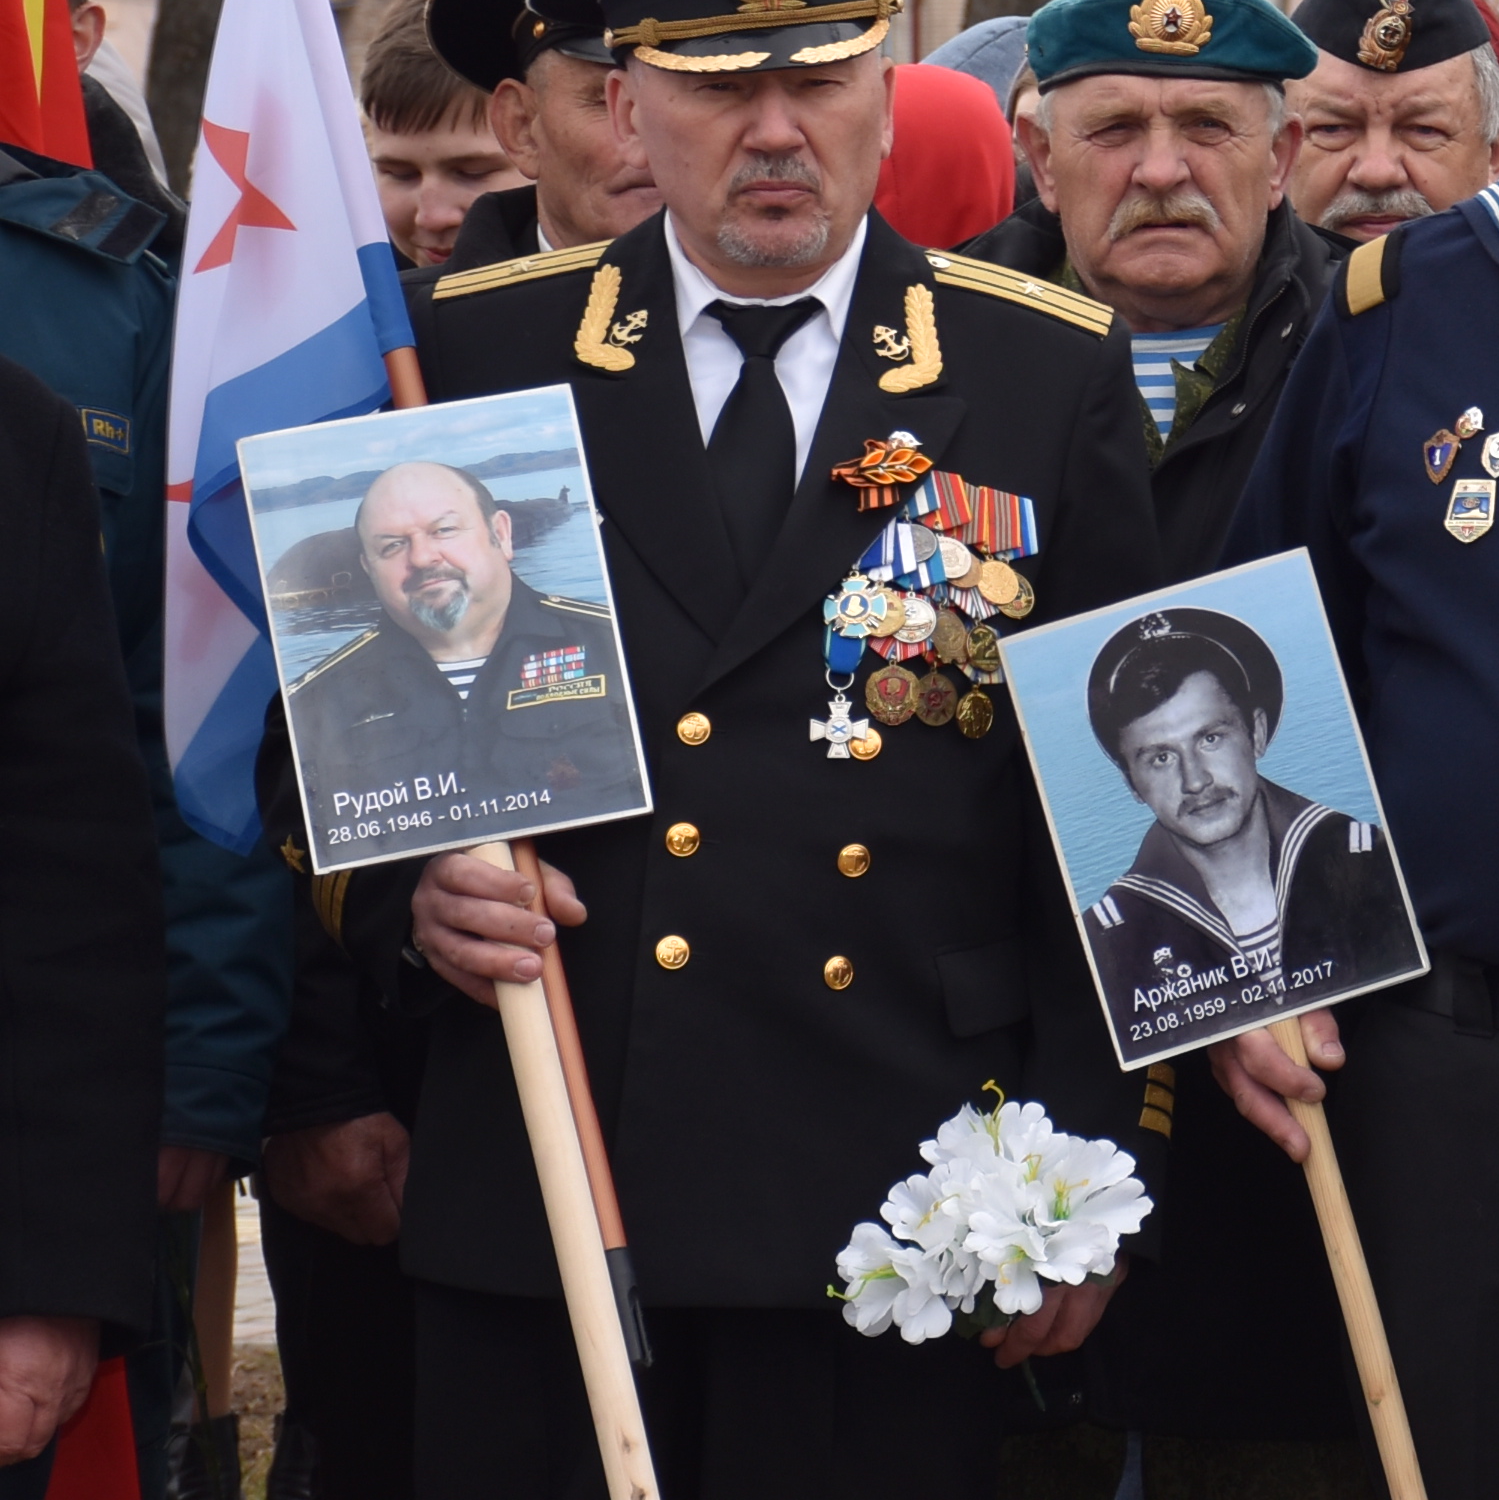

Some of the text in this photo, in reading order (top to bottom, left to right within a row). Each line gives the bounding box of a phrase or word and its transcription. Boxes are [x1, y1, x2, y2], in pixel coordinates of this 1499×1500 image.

[327, 810, 433, 845] 28.06.1946
[450, 789, 551, 821] 01.11.2014
[333, 771, 467, 819] Рудой В.И.
[1129, 997, 1226, 1041] 23.08.1959
[1241, 961, 1333, 1005] 02.11.2017
[1133, 947, 1280, 1012] Аржаник В.И.
